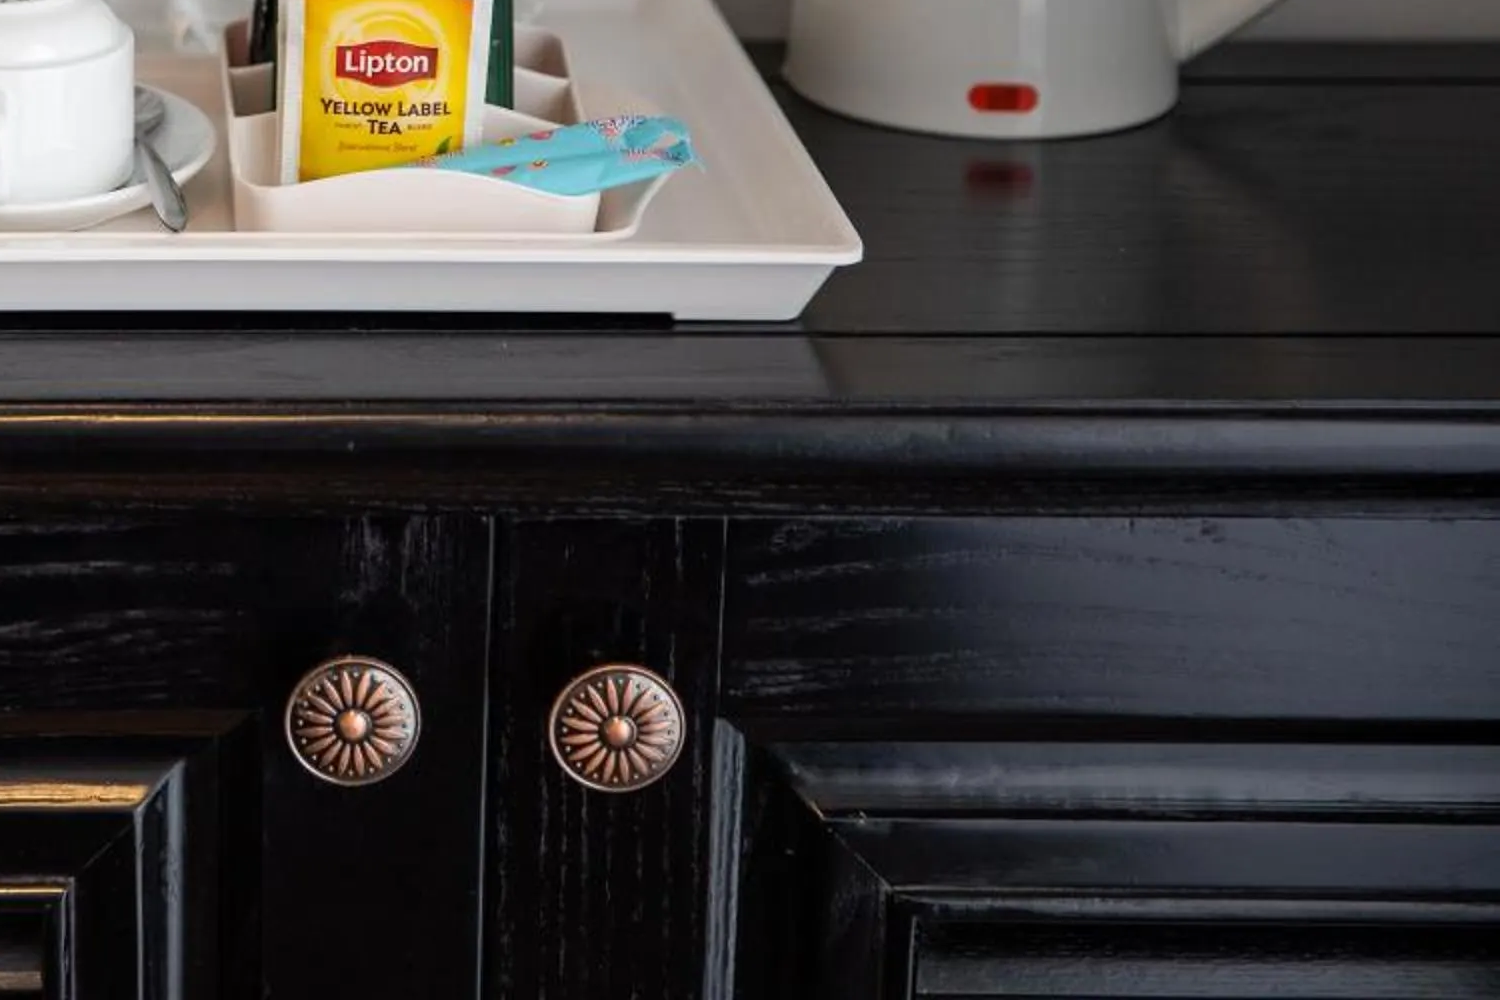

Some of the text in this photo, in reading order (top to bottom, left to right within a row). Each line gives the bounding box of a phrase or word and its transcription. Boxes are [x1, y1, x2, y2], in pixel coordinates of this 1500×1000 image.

[344, 49, 429, 78] Lipton
[320, 97, 452, 117] YELLOW LABEL
[366, 119, 403, 136] TEA
